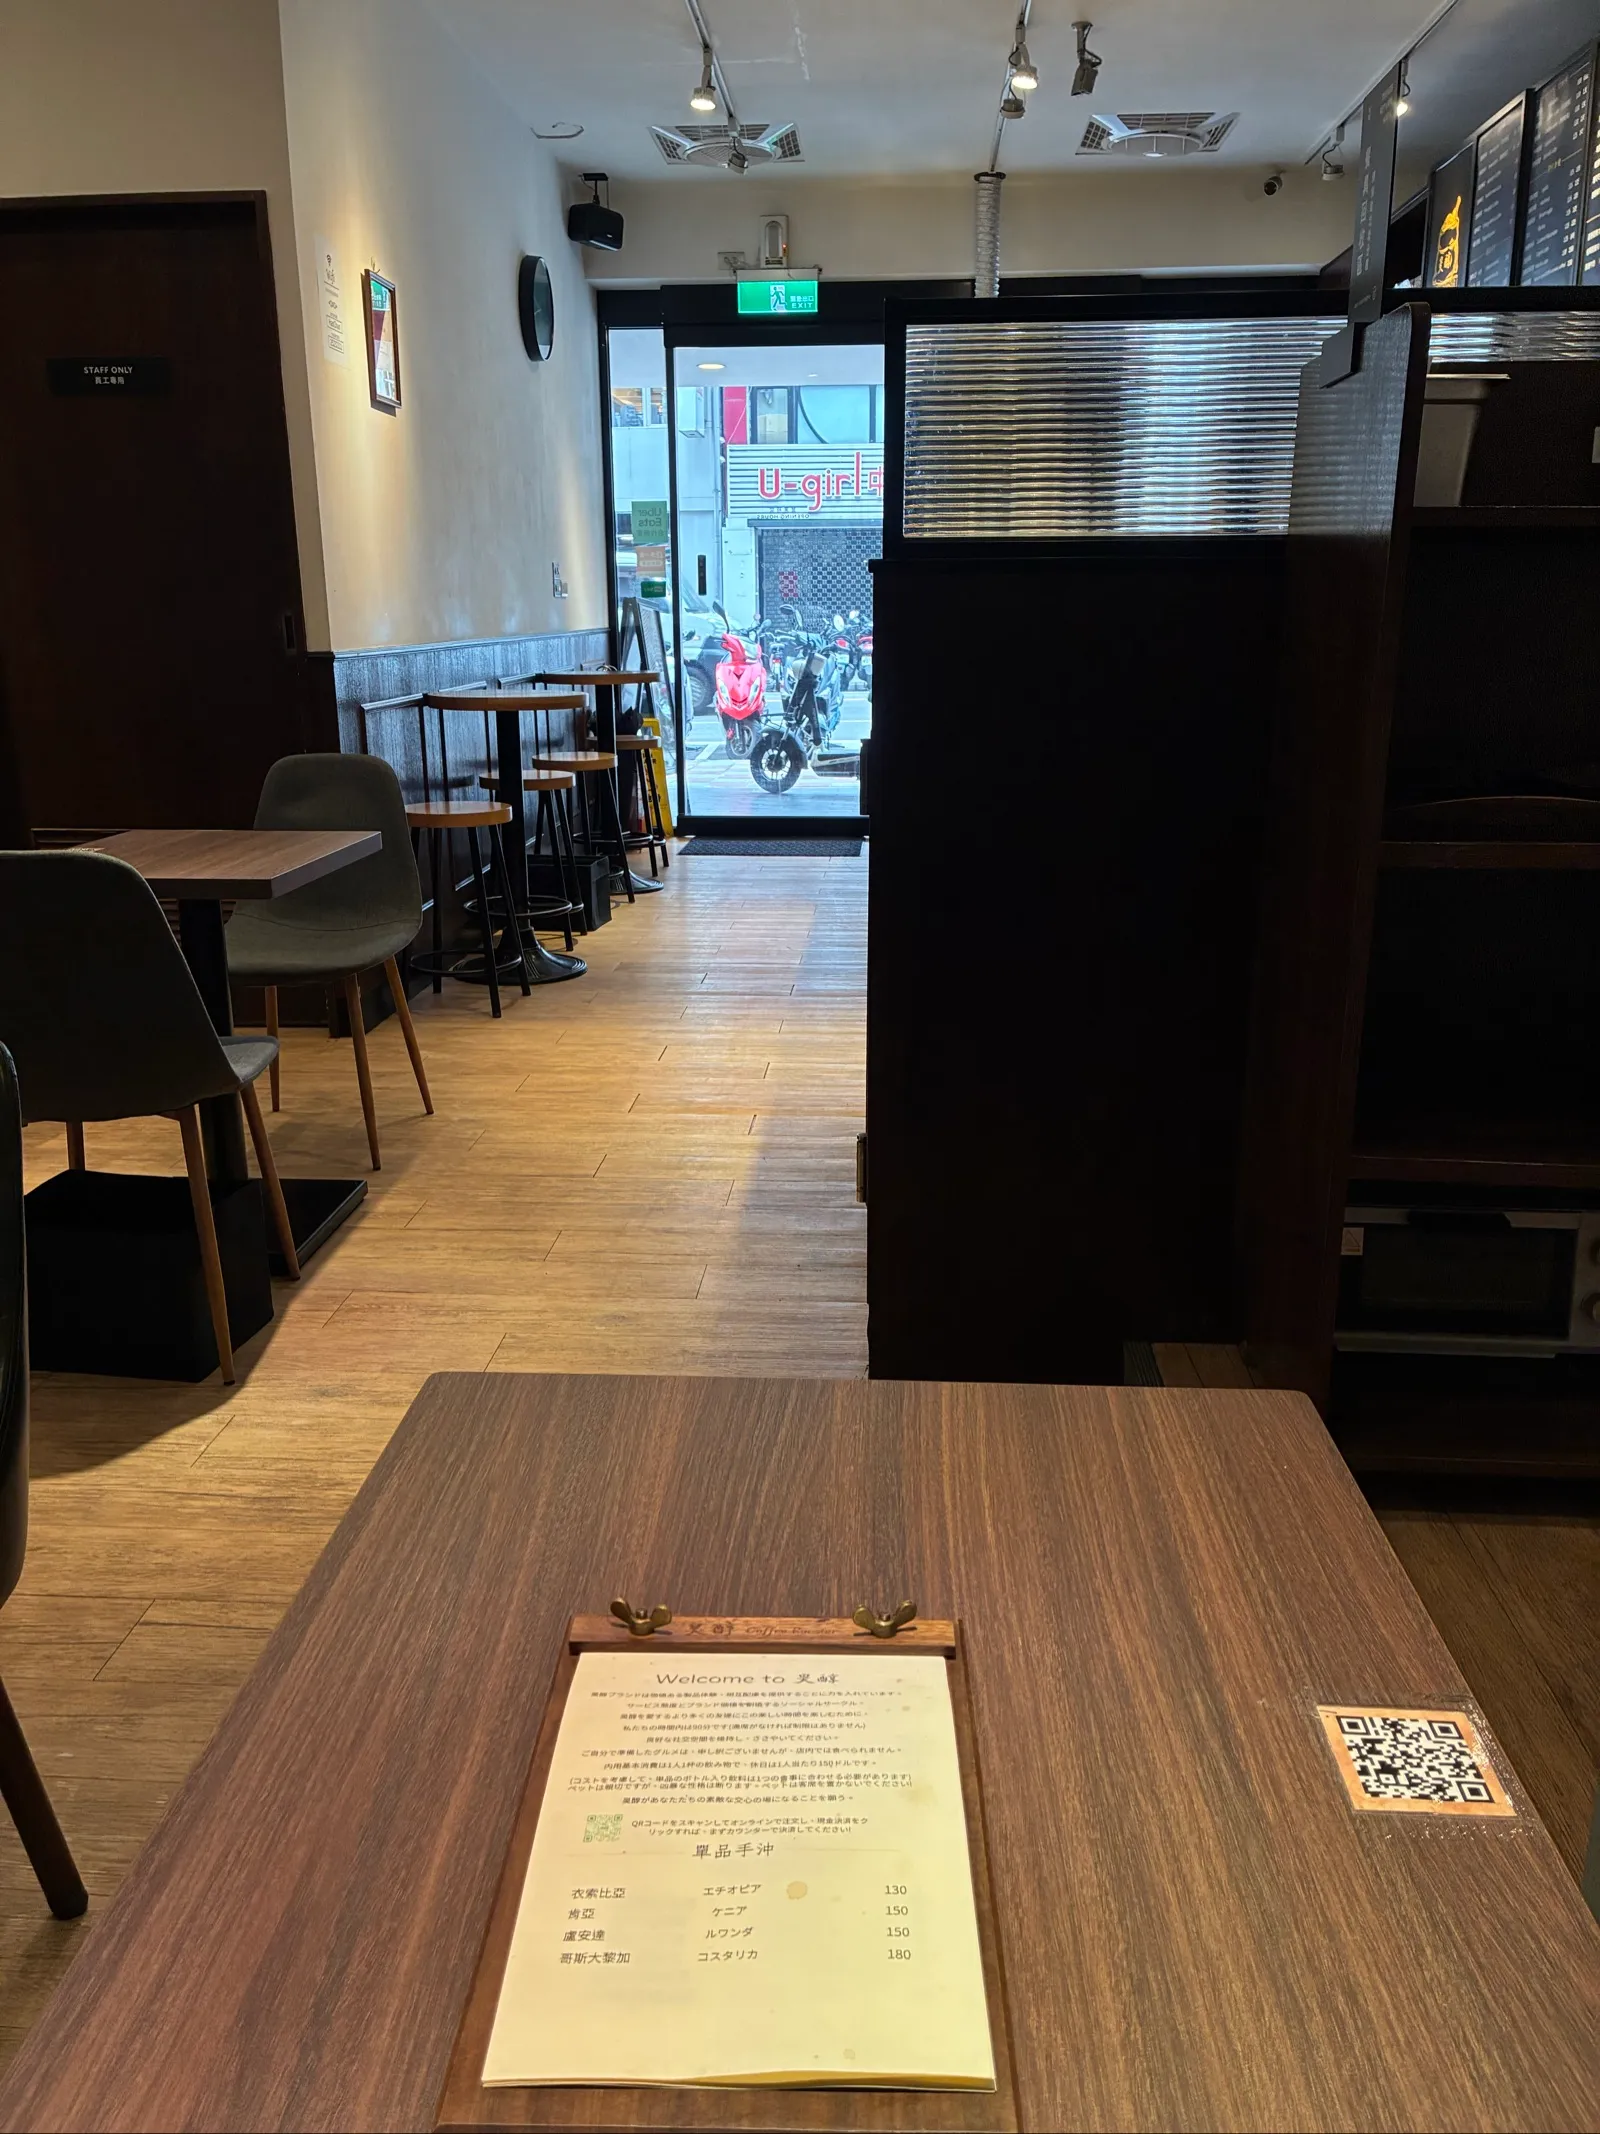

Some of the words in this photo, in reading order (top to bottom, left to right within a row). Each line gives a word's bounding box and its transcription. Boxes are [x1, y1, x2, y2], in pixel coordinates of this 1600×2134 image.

[83, 366, 109, 374] STAFF
[110, 366, 133, 374] ONLY
[759, 452, 861, 511] U-girl
[656, 1674, 755, 1685] Welcome
[763, 1674, 785, 1684] to
[692, 1842, 775, 1859] 單品手沖
[571, 1887, 626, 1900] 衣索比亞
[703, 1883, 762, 1897] エチオピア
[885, 1884, 907, 1896] 130
[568, 1908, 596, 1920] 肯亞
[712, 1905, 748, 1917] ケニア
[885, 1905, 908, 1917] 150
[562, 1929, 606, 1942] 盧安達
[705, 1926, 754, 1940] ルワンダ
[887, 1926, 910, 1938] 150
[559, 1951, 631, 1965] 哥斯大黎加
[697, 1949, 758, 1963] コスタリカ
[887, 1949, 912, 1961] 180
